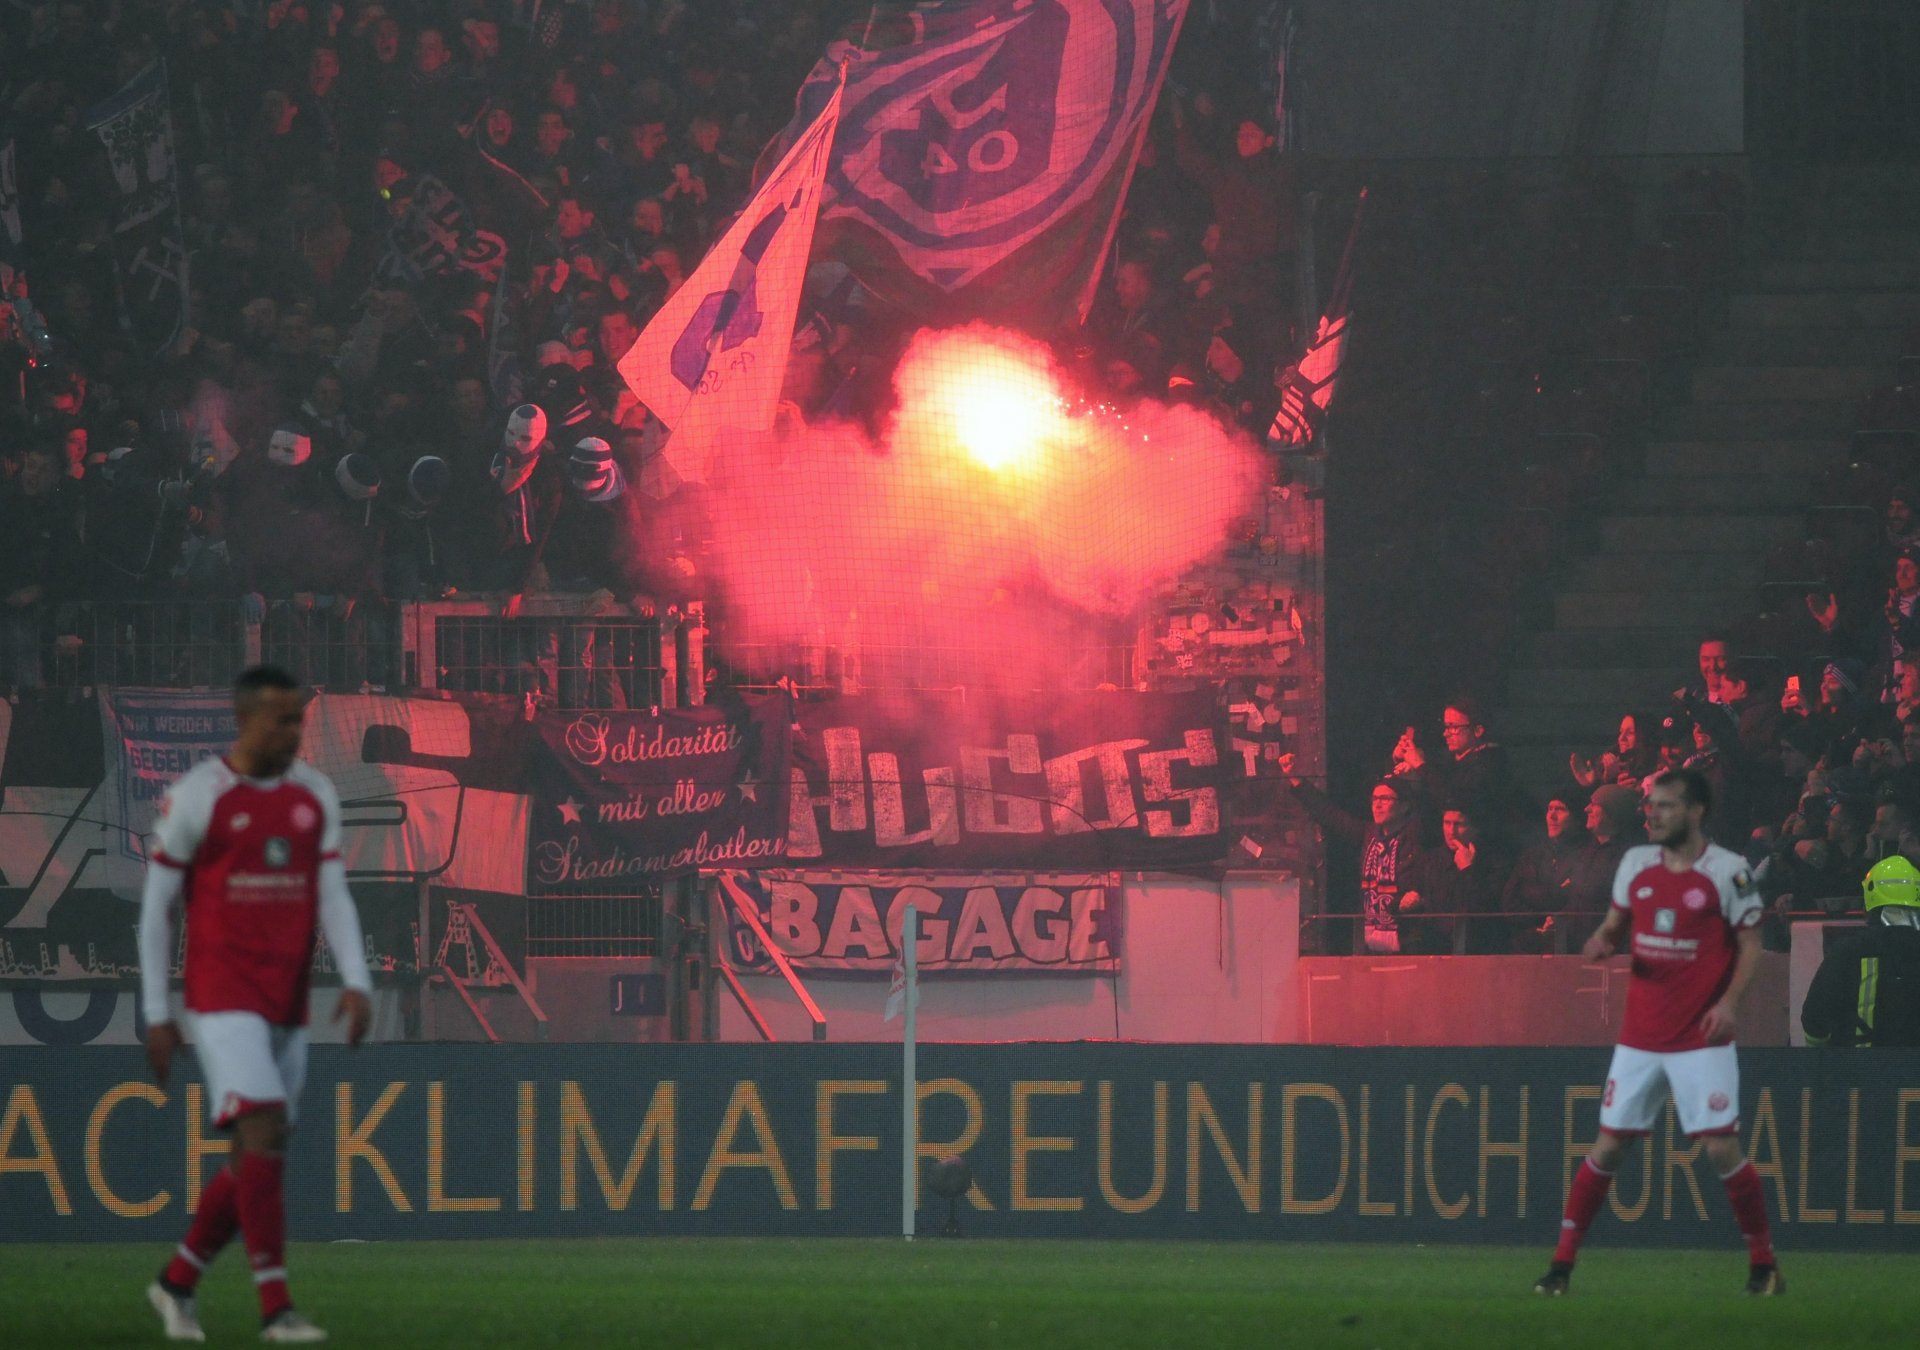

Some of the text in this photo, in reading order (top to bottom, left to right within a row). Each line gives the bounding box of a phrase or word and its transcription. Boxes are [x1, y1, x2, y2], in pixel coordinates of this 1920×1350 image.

[154, 714, 213, 733] WERDEN
[565, 712, 743, 765] Solidarität
[131, 747, 192, 773] GEGEN
[598, 777, 726, 823] mit aller
[786, 726, 1220, 857] HUGOS
[535, 825, 788, 885] Stadionverbotlern
[770, 879, 1110, 965] BAGAGE
[335, 1079, 1529, 1220] KLIMAFREUNDLICH
